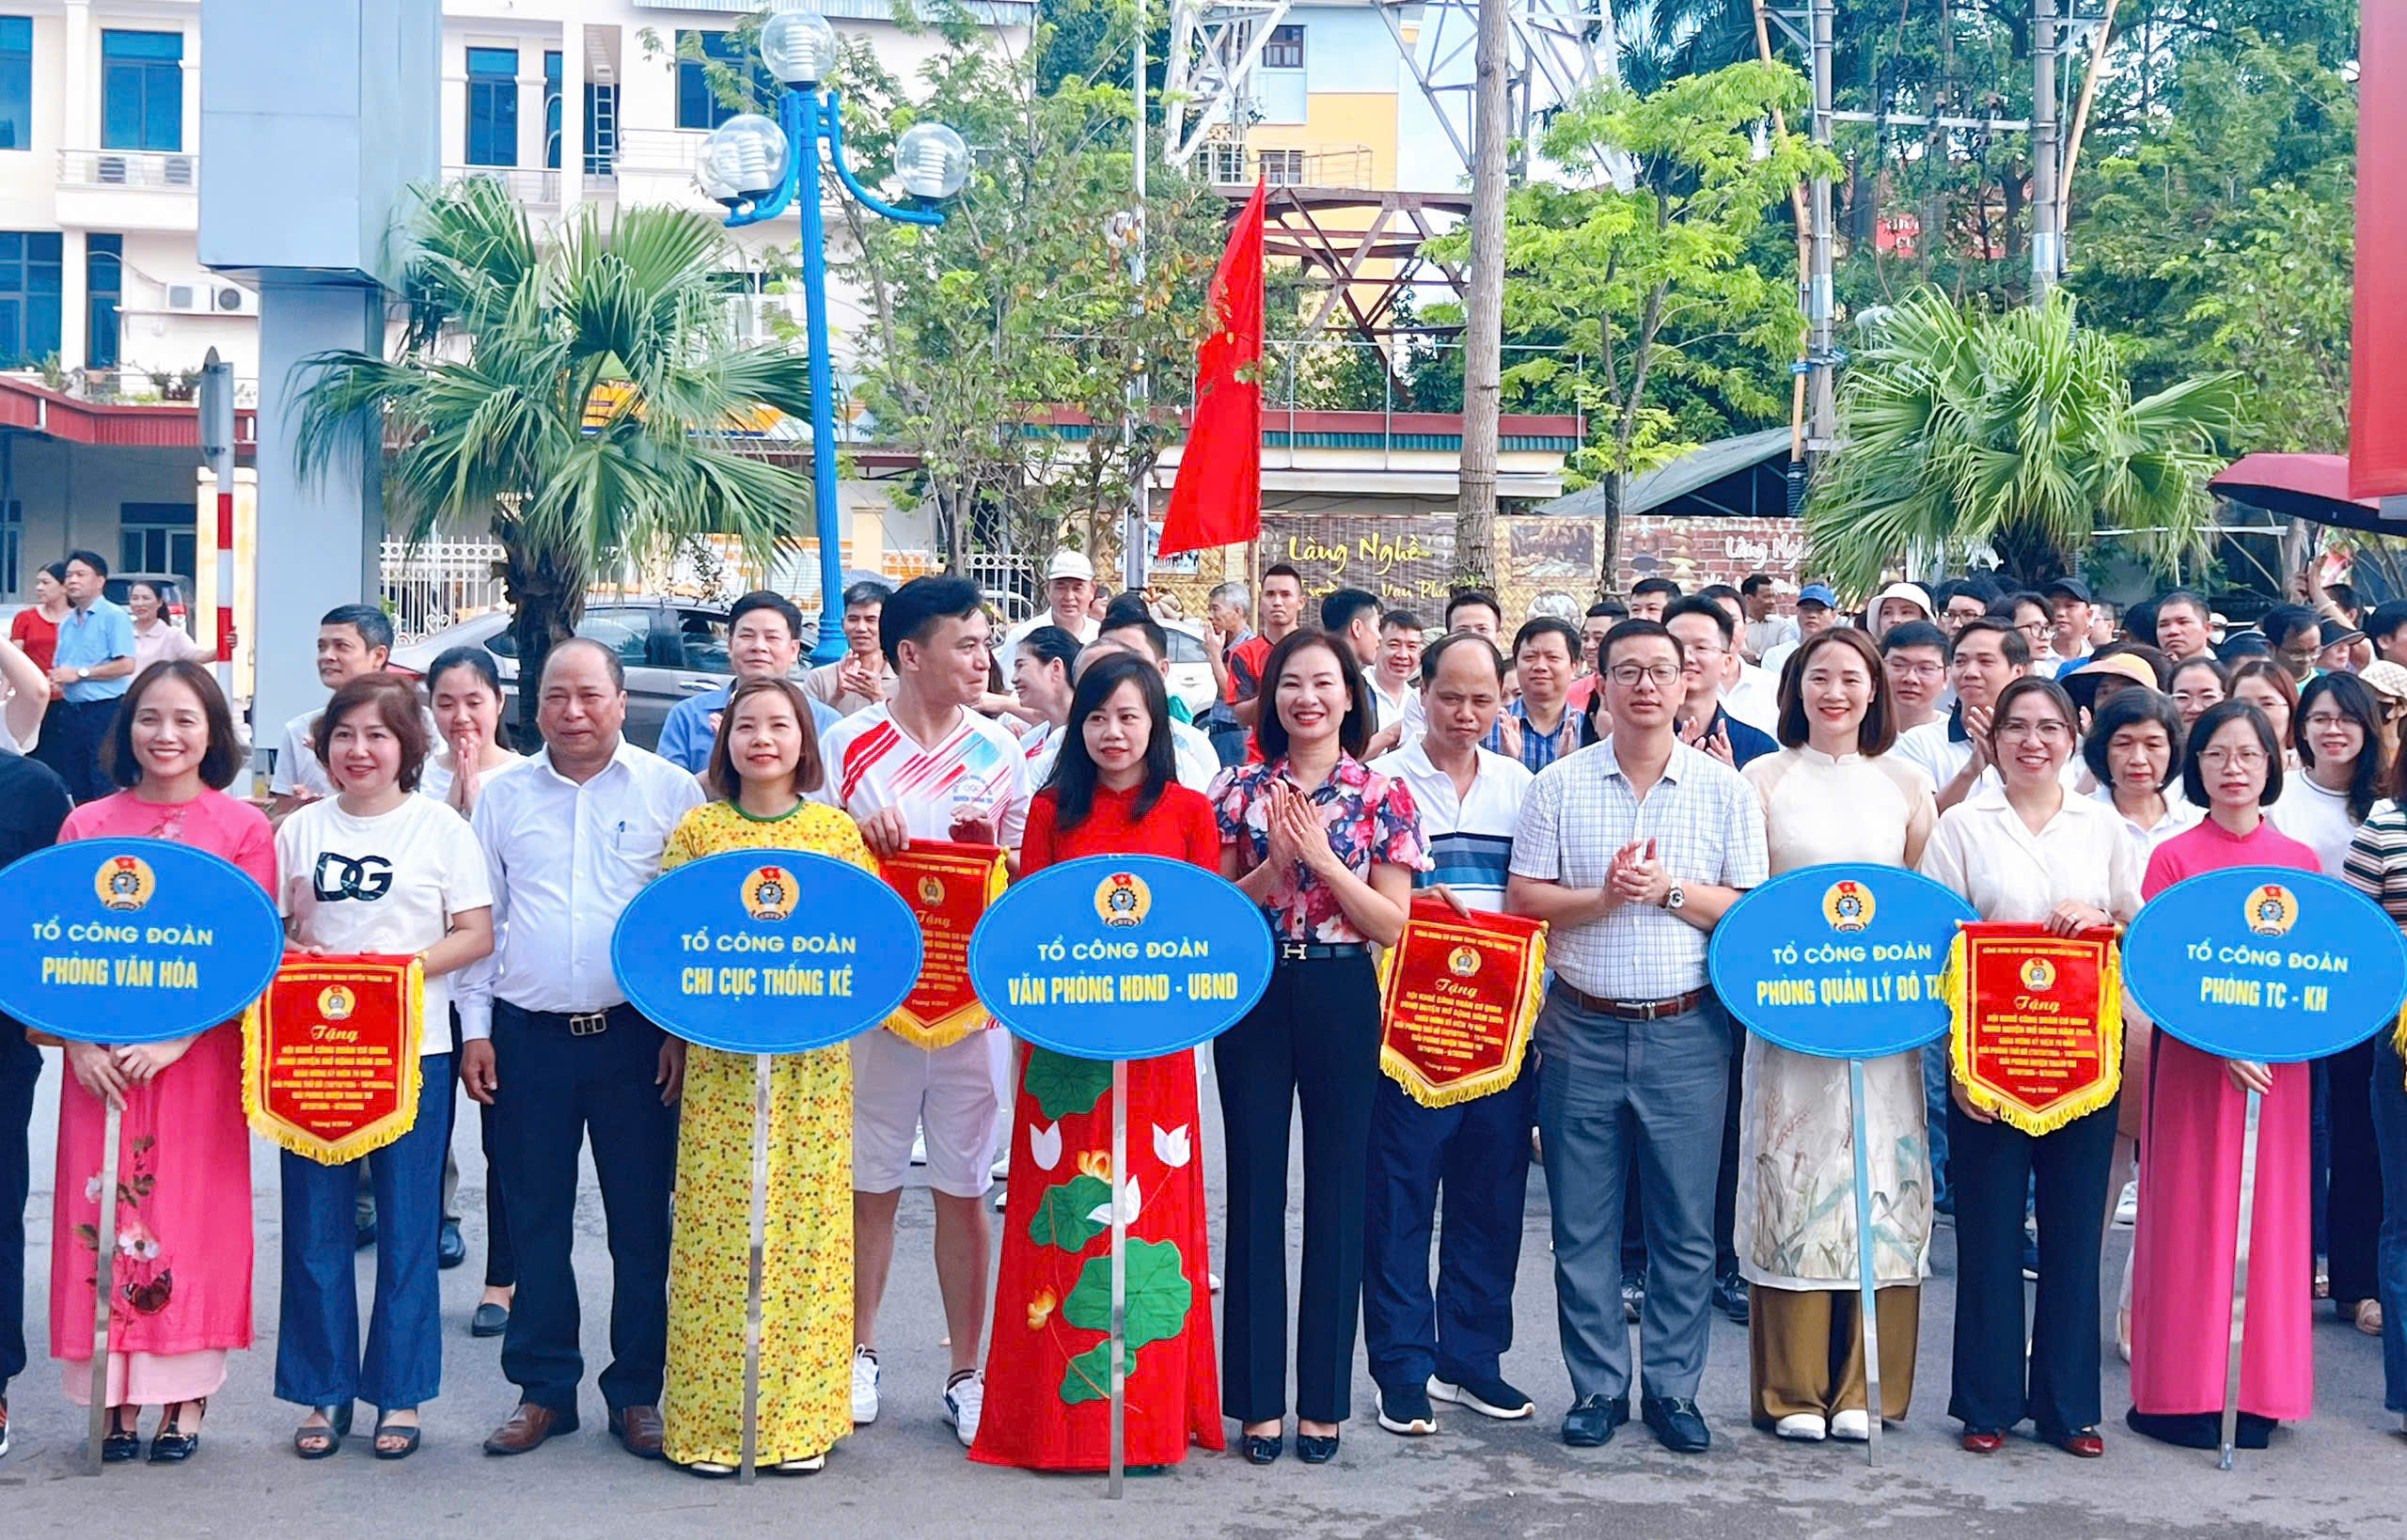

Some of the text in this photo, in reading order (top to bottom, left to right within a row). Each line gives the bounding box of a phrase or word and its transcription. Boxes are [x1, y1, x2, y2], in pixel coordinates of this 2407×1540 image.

[1288, 531, 1428, 575] Làng Nghề
[1724, 535, 1769, 571] Làng
[313, 851, 393, 903] DG
[33, 915, 213, 946] TỔ CÔNG ĐOÀN
[682, 925, 857, 954] TỔ CÔNG ĐOÀN
[1037, 935, 1209, 961] TỔ CÔNG ĐOÀN
[41, 951, 198, 989] PHÒNG VĂN HÓA
[1771, 939, 1932, 966] TỔ CÔNG ĐOÀN
[2186, 936, 2349, 973] TỔ CÔNG ĐOÀN
[682, 960, 854, 1001] CHI CỤC THỐNG KÊ
[1008, 972, 1046, 1006] VĂN
[1051, 969, 1114, 1004] PHÒNG
[1188, 972, 1239, 1001] UBND
[1756, 973, 1817, 1007] PHÒNG
[1819, 969, 1868, 1007] QUẢN
[1872, 971, 1892, 1003] LÝ
[1896, 969, 1920, 1002] ĐÔ
[2200, 973, 2260, 1008] PHÒNG
[2266, 982, 2288, 1009] TC
[2304, 984, 2329, 1013] KH
